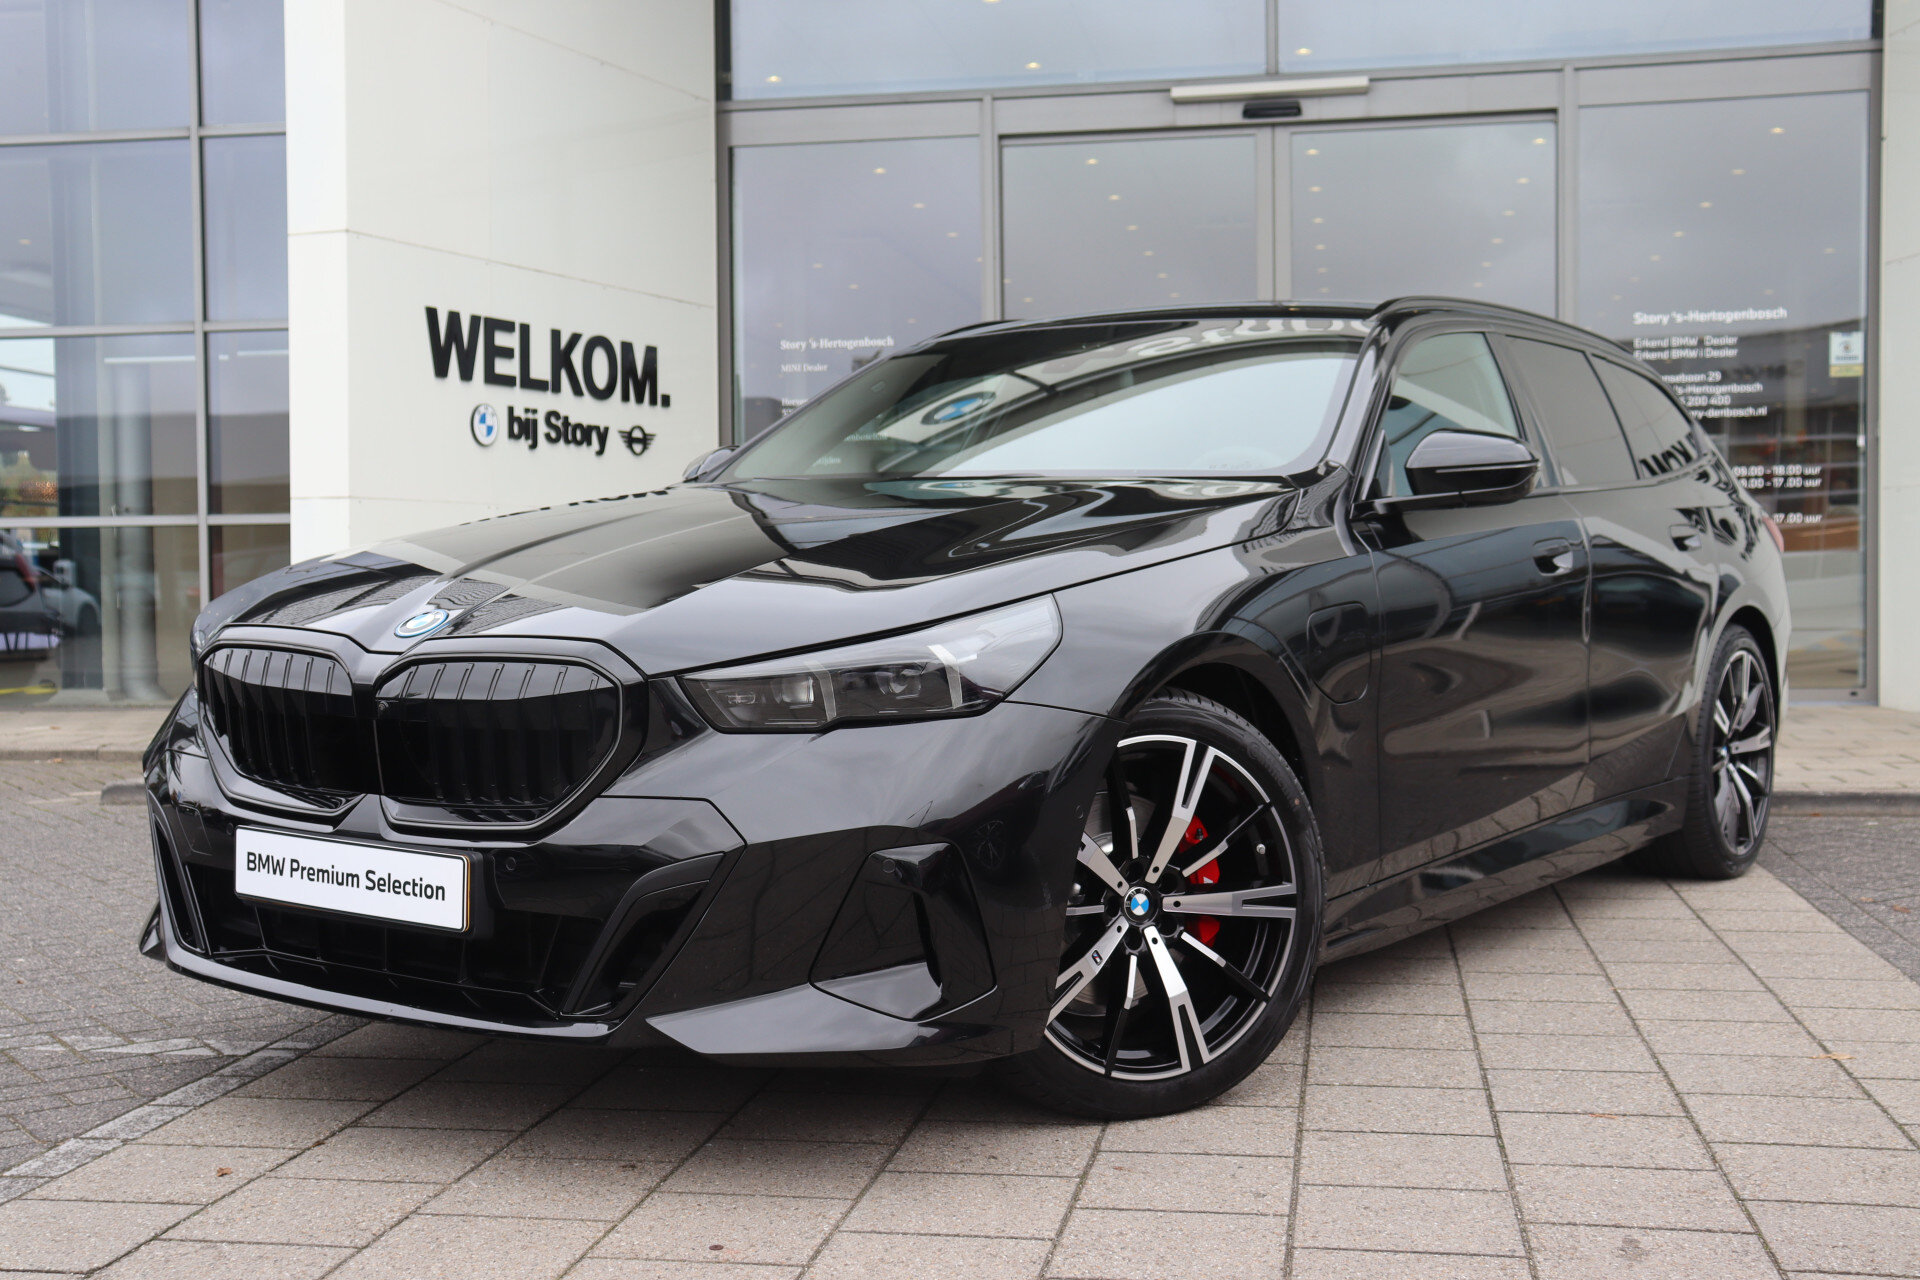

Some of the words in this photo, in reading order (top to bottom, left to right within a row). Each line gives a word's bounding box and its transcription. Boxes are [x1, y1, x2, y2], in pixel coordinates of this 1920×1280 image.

[1633, 311, 1669, 325] Story
[1671, 307, 1787, 324] 's-Hertogenbosch
[780, 340, 806, 352] Story
[1633, 337, 1669, 349] Erkend
[1671, 335, 1698, 347] BMW
[1703, 335, 1738, 347] Dealer
[425, 306, 671, 408] WELKOM.
[1633, 349, 1669, 361] Erkend
[1671, 348, 1698, 359] BMW
[1704, 347, 1738, 358] Dealer
[803, 362, 828, 373] Dealer
[1707, 371, 1721, 382] 29
[1686, 396, 1708, 407] 200
[1709, 395, 1731, 406] 400
[507, 406, 537, 450] bij
[544, 410, 609, 456] Story
[1803, 466, 1822, 476] uur
[1803, 478, 1822, 488] uur
[1803, 514, 1822, 523] uur
[247, 852, 285, 876] BMW
[290, 858, 360, 889] Premium
[365, 870, 446, 901] Selection
